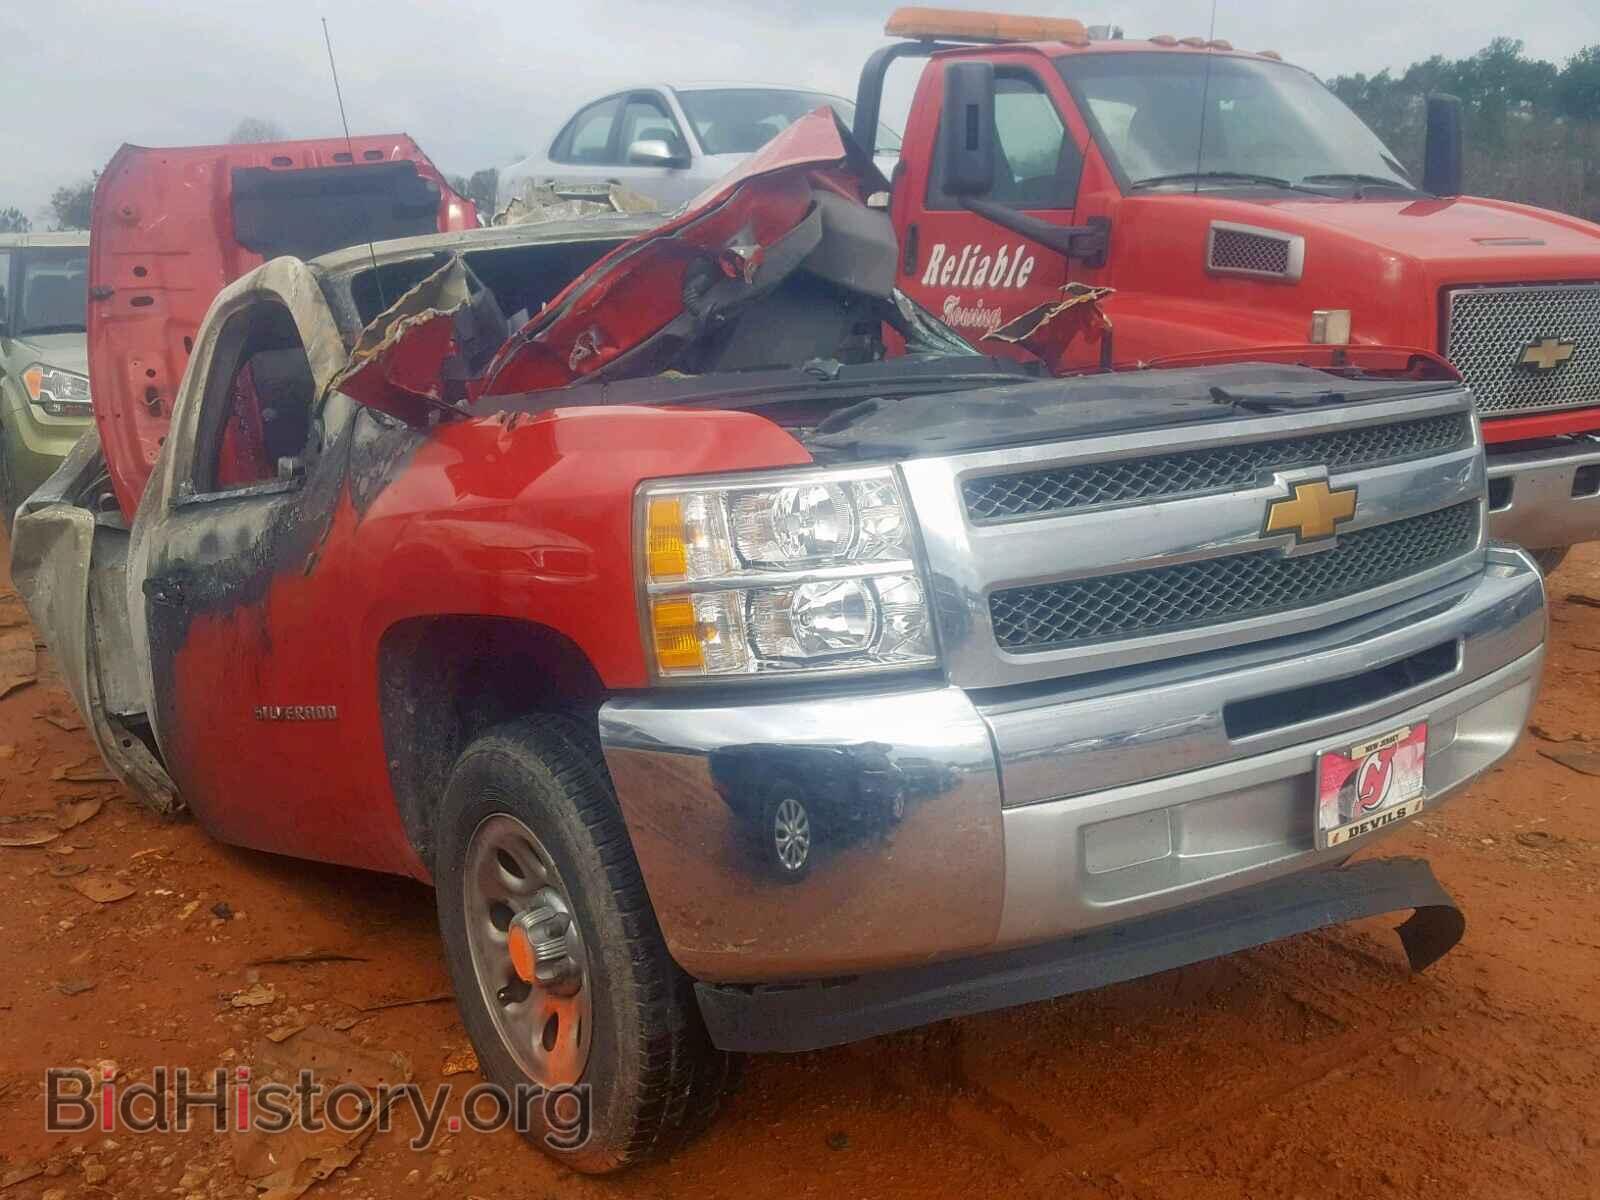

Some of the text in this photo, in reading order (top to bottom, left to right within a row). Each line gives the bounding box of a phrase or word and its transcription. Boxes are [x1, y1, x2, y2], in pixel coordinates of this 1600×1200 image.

[921, 243, 1035, 288] Reliable
[942, 294, 1002, 332] Towing
[255, 703, 337, 721] SILVERADO
[1365, 742, 1379, 752] NEW
[1348, 807, 1407, 839] DEVILS
